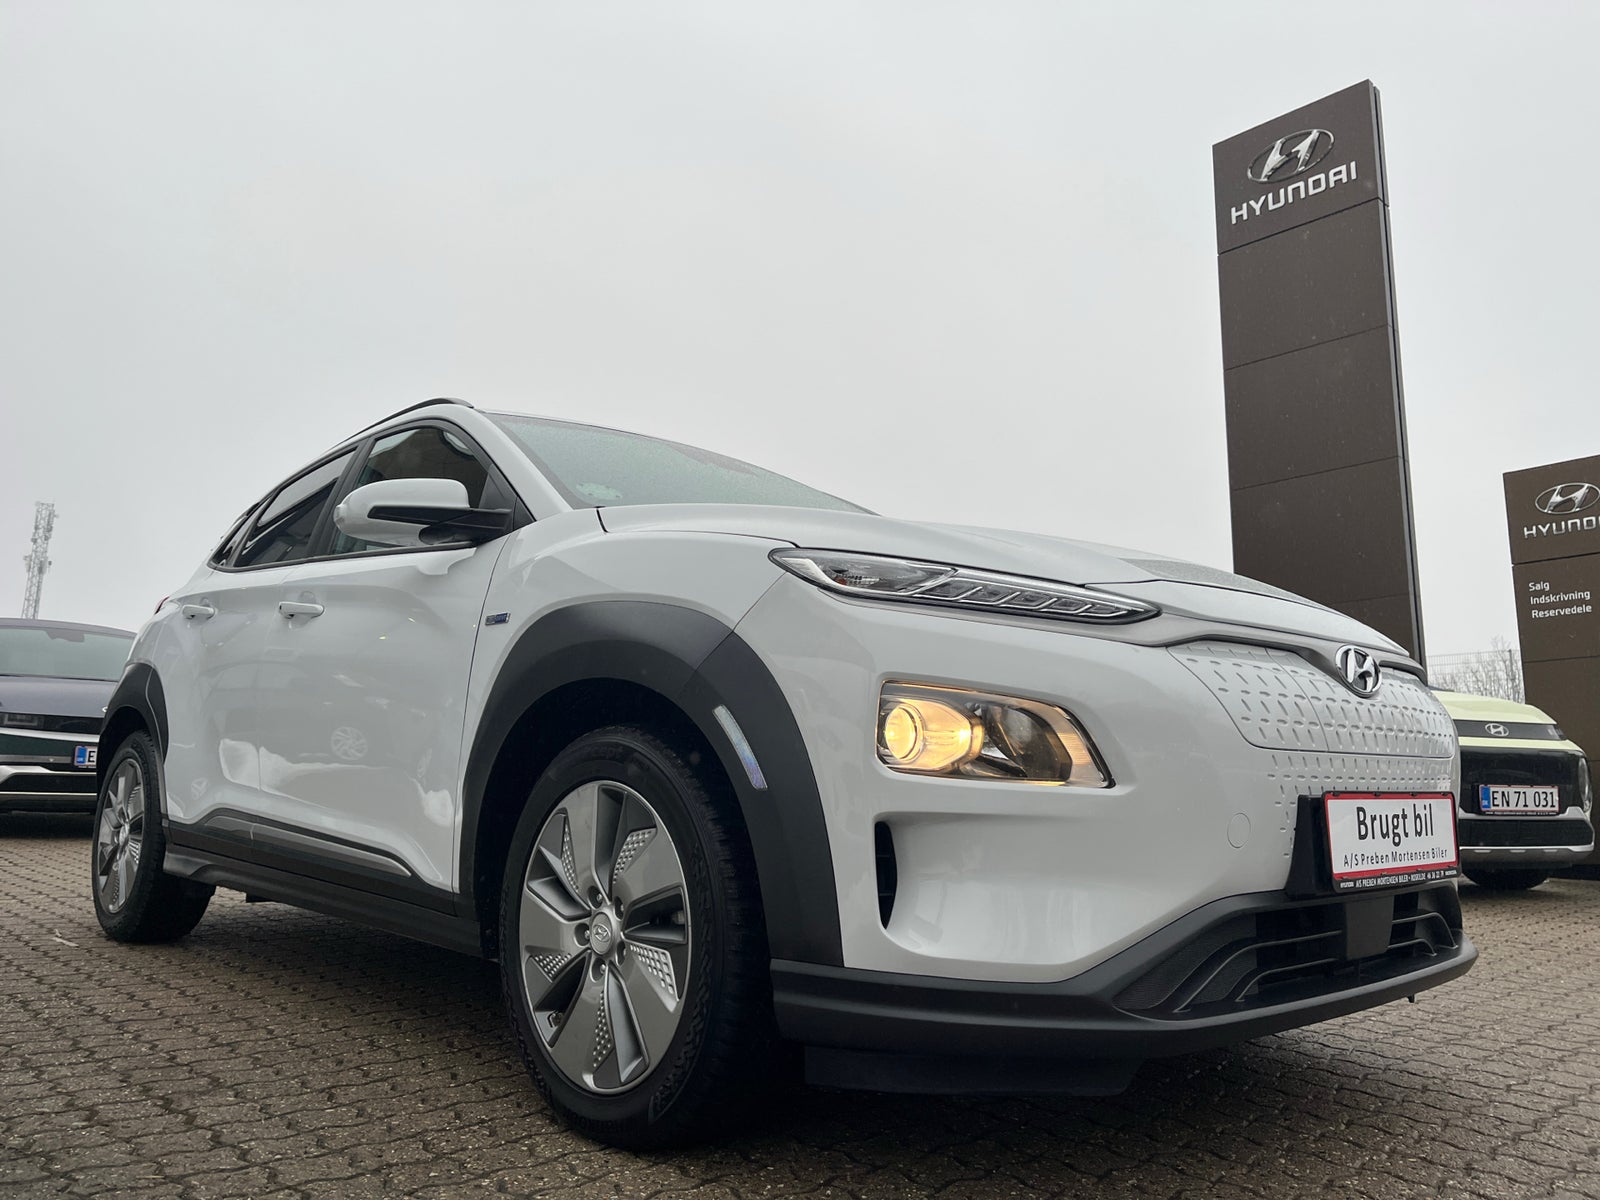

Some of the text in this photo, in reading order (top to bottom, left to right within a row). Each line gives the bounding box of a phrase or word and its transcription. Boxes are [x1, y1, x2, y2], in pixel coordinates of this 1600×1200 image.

[1230, 160, 1357, 225] HYUNDAI
[1524, 516, 1600, 538] HYUND
[1528, 581, 1550, 592] Salg
[1530, 591, 1590, 605] Indskrivning
[1531, 604, 1592, 618] Reservedele
[1491, 790, 1556, 808] EN 71 031
[1356, 803, 1434, 847] Brugt bil
[1343, 847, 1447, 869] A/S Preben Mortensen Biler
